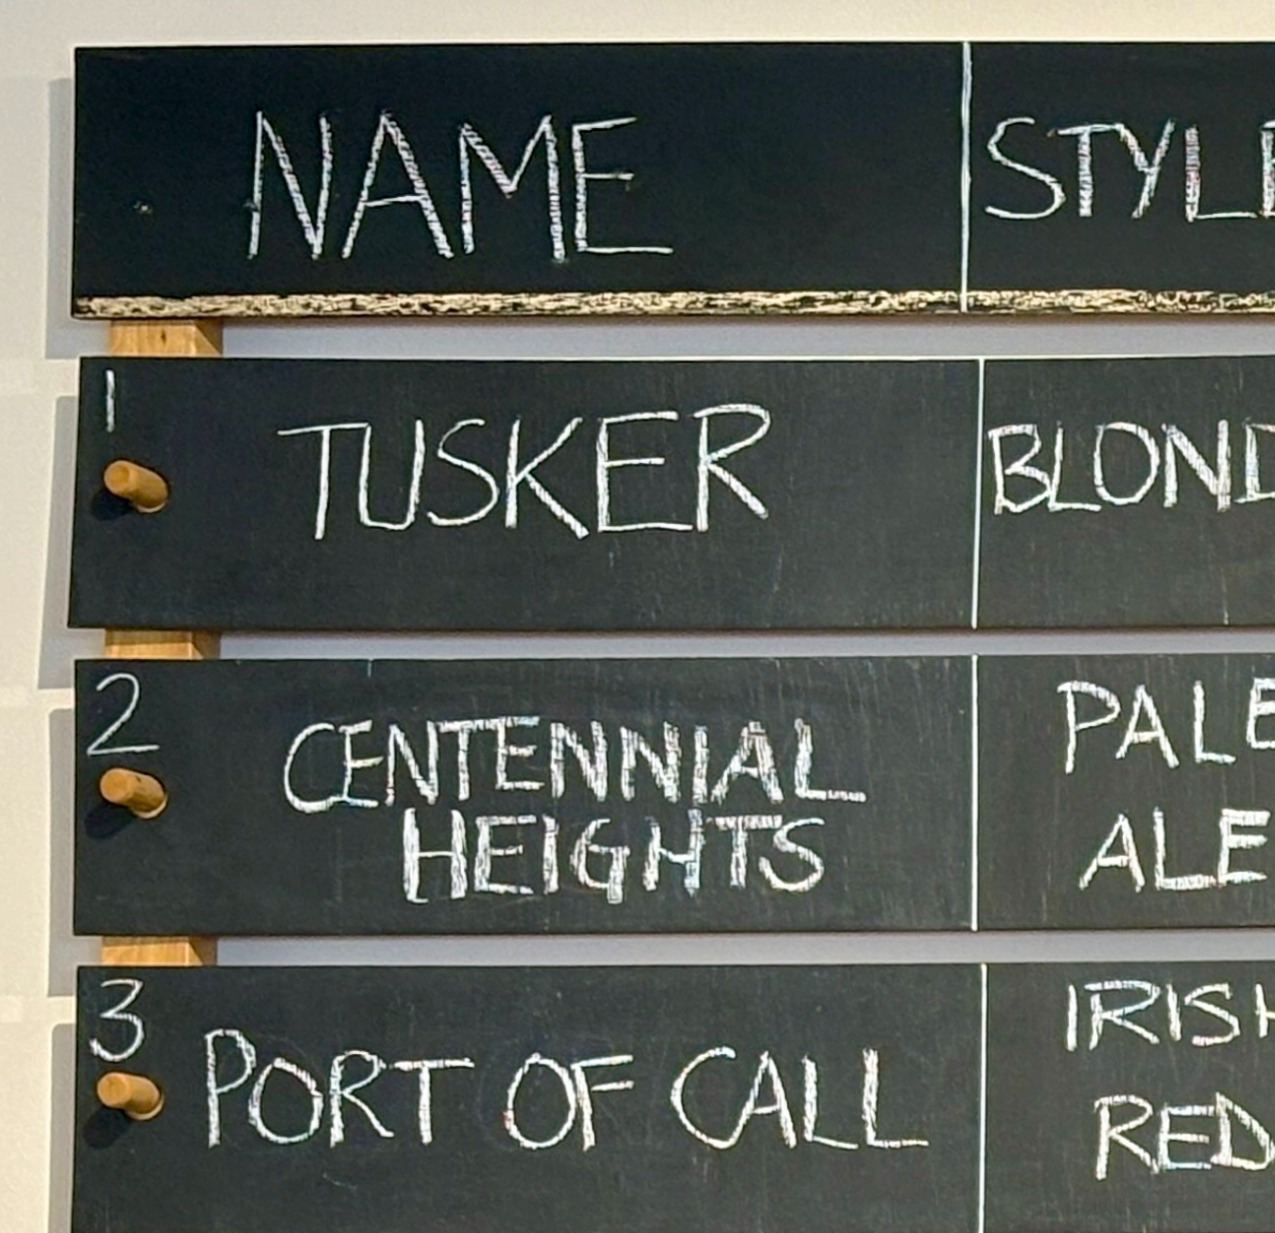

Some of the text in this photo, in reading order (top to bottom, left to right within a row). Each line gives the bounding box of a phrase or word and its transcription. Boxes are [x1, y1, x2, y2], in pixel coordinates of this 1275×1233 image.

[248, 111, 673, 262] NAME
[105, 370, 116, 431] 1
[278, 403, 772, 541] TUSKER
[88, 673, 159, 755] 2
[283, 716, 867, 812] CENTENNIAL
[402, 808, 827, 903] HEIGHTS
[1079, 807, 1271, 893] ALE
[90, 980, 144, 1062] 3
[204, 1028, 930, 1151] PORT OF CALL
